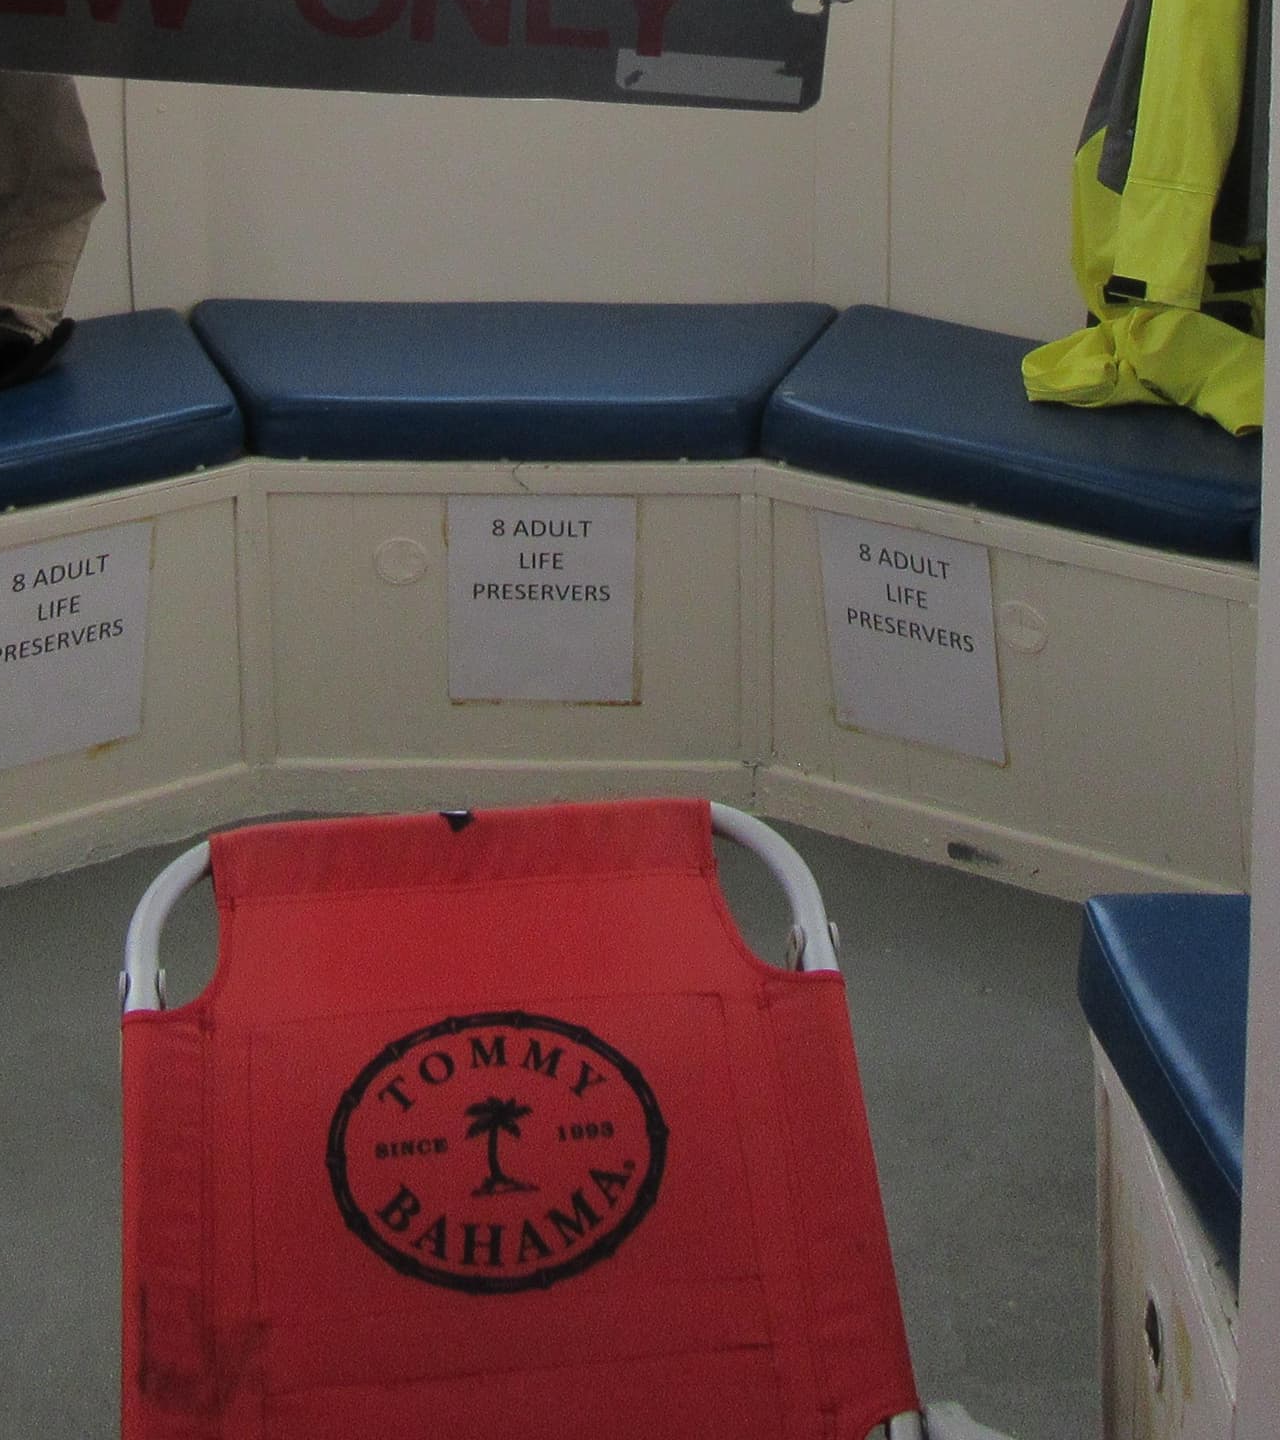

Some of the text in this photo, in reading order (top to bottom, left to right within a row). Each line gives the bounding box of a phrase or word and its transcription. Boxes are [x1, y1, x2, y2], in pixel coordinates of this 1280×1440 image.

[491, 519, 592, 538] 8 ADULT
[11, 553, 110, 593] 8 ADULT
[519, 552, 564, 570] LIFE
[859, 543, 950, 580] 8 ADULT
[472, 583, 611, 602] PRESERVERS
[886, 583, 928, 609] LIFE
[37, 595, 81, 621] LIFE
[847, 607, 974, 653] PRESERVERS
[378, 1035, 607, 1113] TOMMY
[375, 1137, 449, 1159] SINCE
[376, 1166, 632, 1266] BAHAMA
